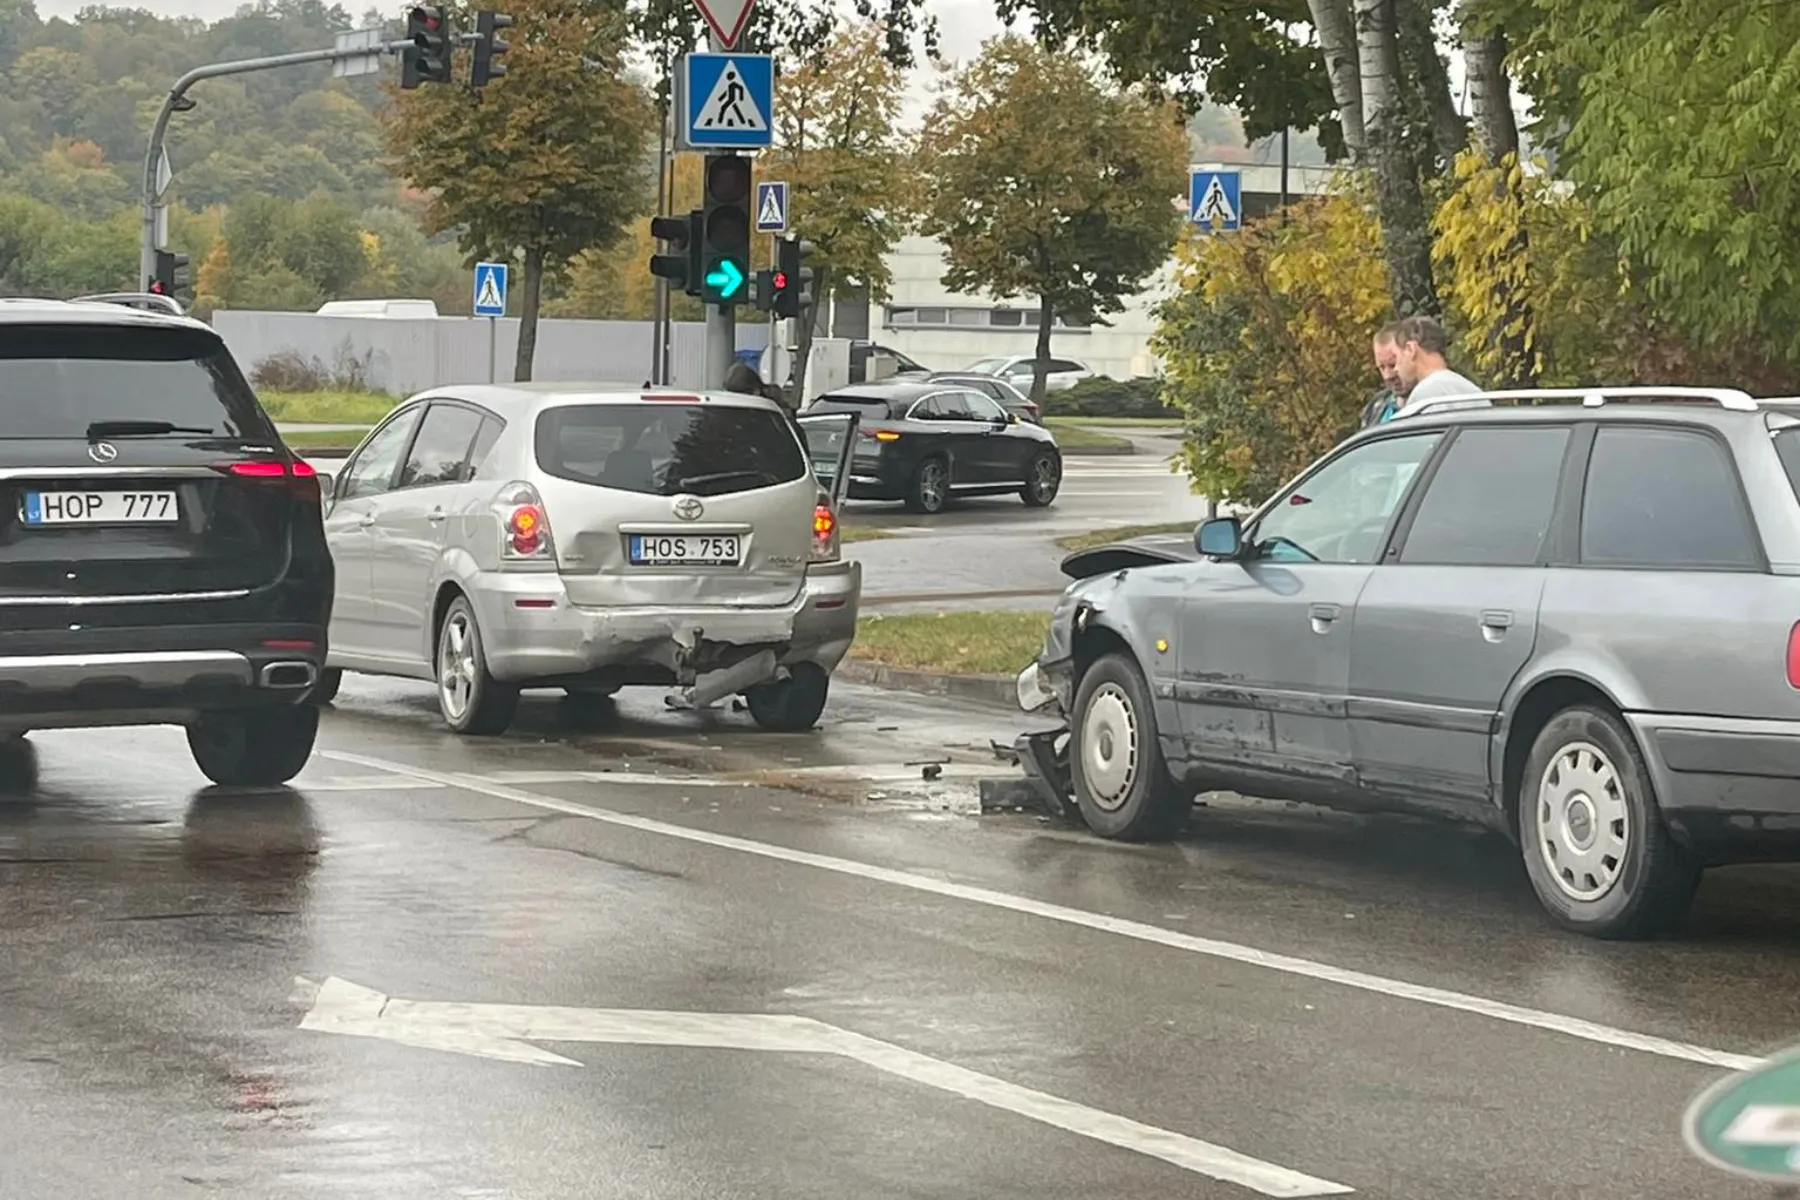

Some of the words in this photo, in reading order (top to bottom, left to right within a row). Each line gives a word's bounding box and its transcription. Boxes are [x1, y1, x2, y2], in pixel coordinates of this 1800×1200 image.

[45, 495, 102, 519] HOP
[123, 494, 170, 518] 777
[645, 538, 686, 557] HOS
[700, 538, 736, 557] 753
